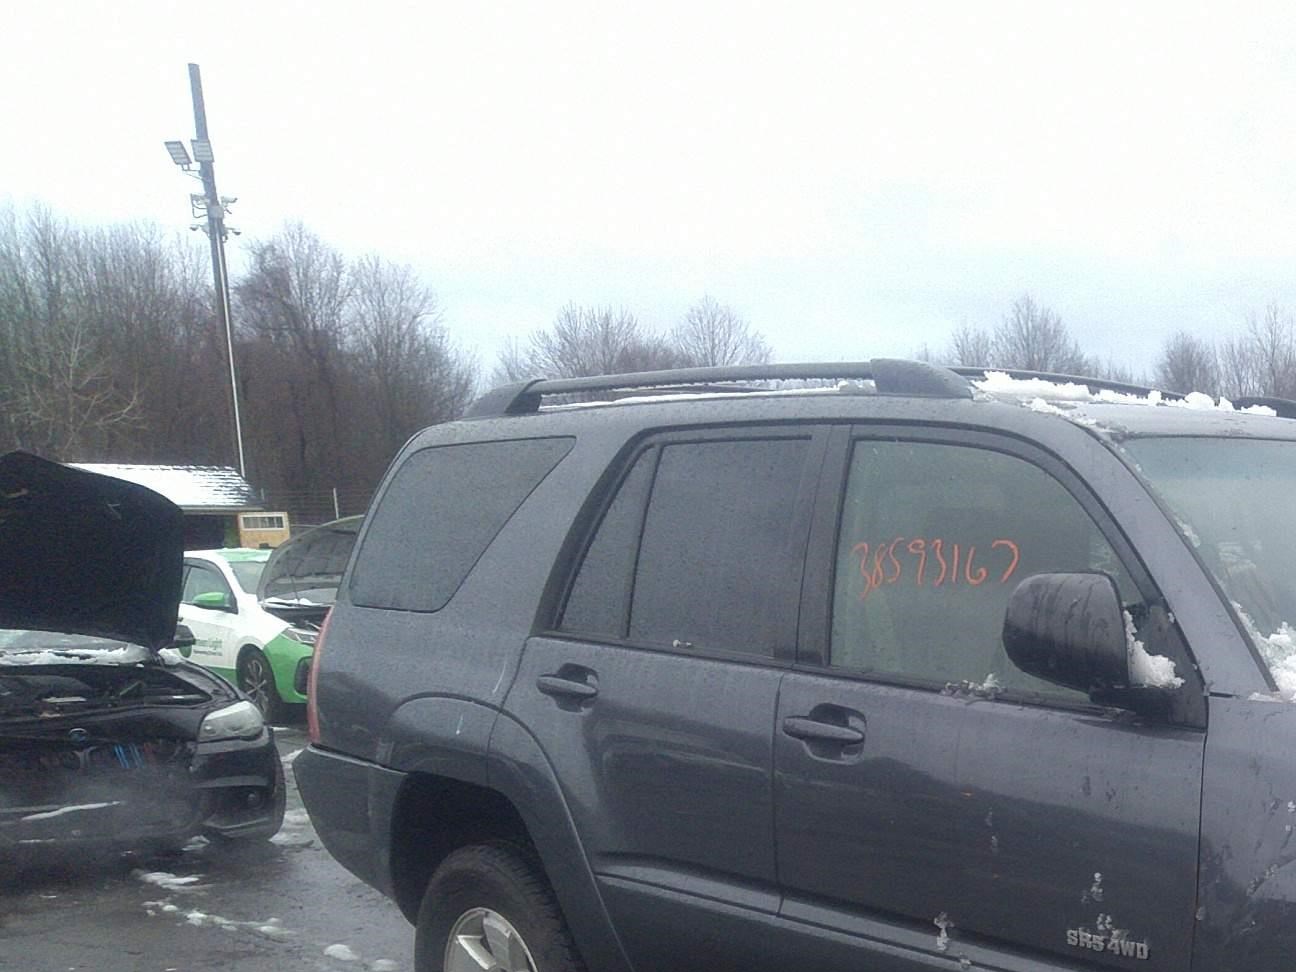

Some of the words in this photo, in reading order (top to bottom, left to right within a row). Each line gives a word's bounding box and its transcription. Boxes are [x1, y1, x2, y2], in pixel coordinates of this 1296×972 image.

[852, 537, 1021, 600] 38593167
[1066, 929, 1105, 952] SR5
[1106, 937, 1150, 960] 4WD
